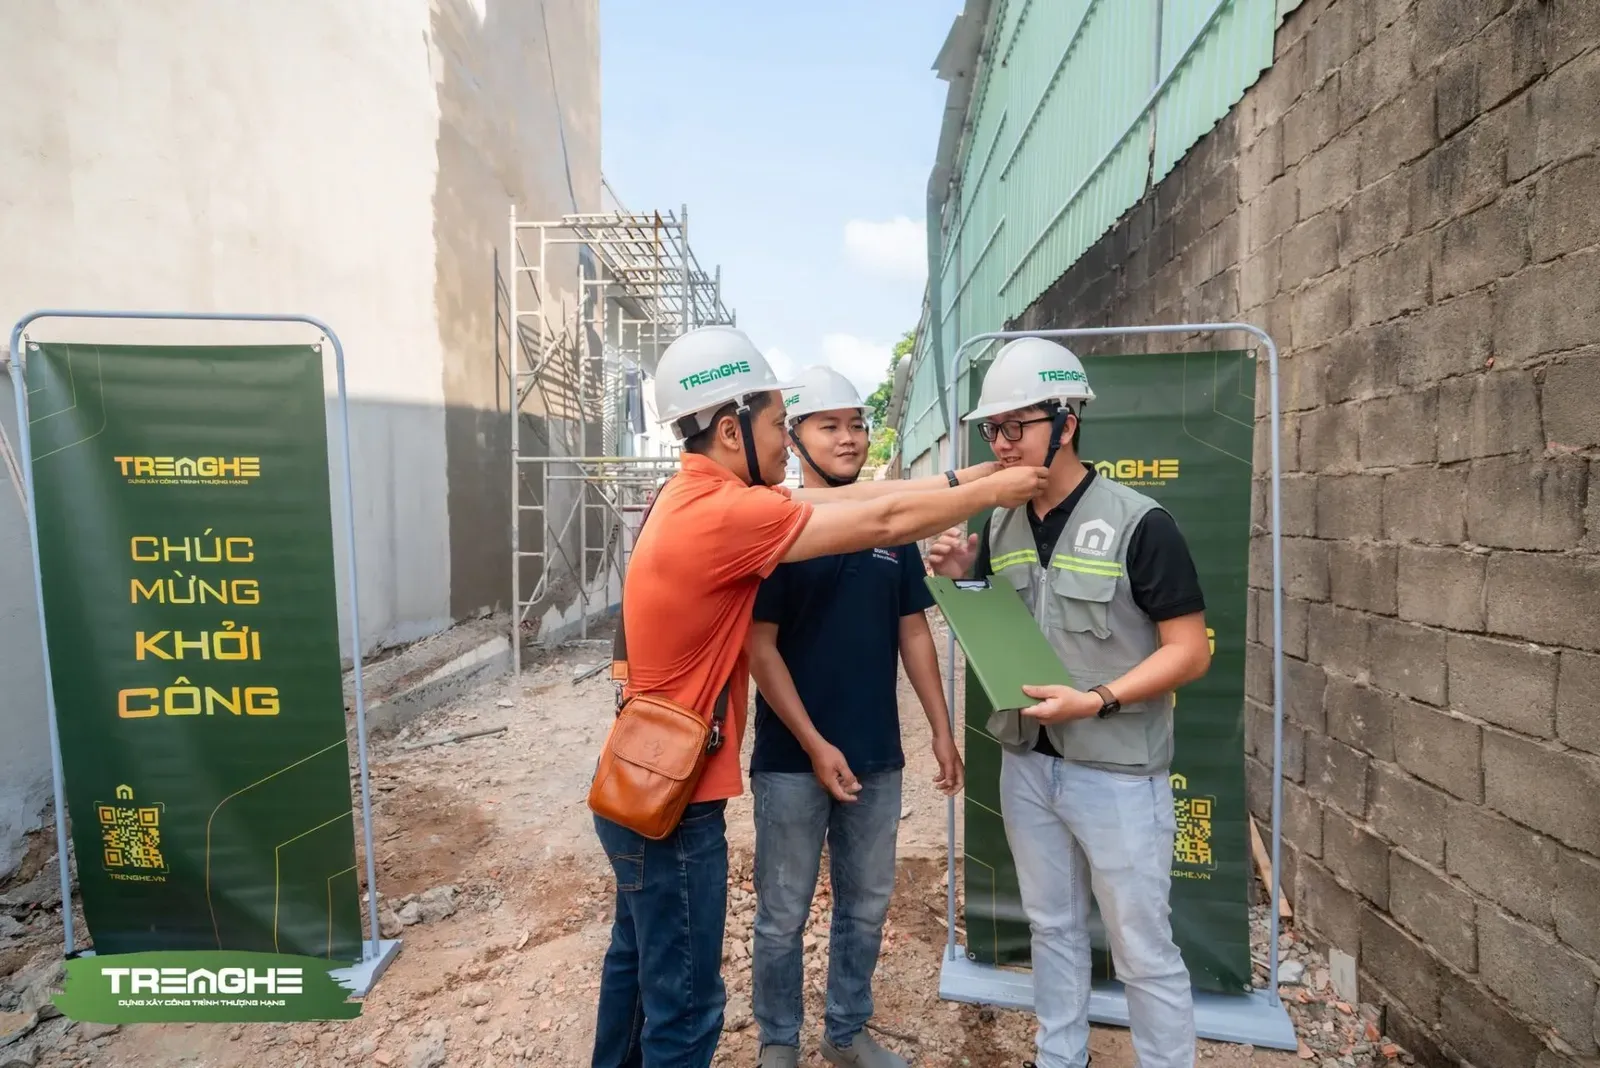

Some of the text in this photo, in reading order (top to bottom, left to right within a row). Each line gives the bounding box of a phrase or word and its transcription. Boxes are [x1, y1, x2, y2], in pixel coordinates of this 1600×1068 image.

[131, 528, 254, 563] CHÚC
[130, 570, 260, 604] MỪNG
[136, 620, 261, 661] KHỞI
[118, 676, 280, 719] CÔNG
[109, 873, 166, 882] TRENGHE.VN
